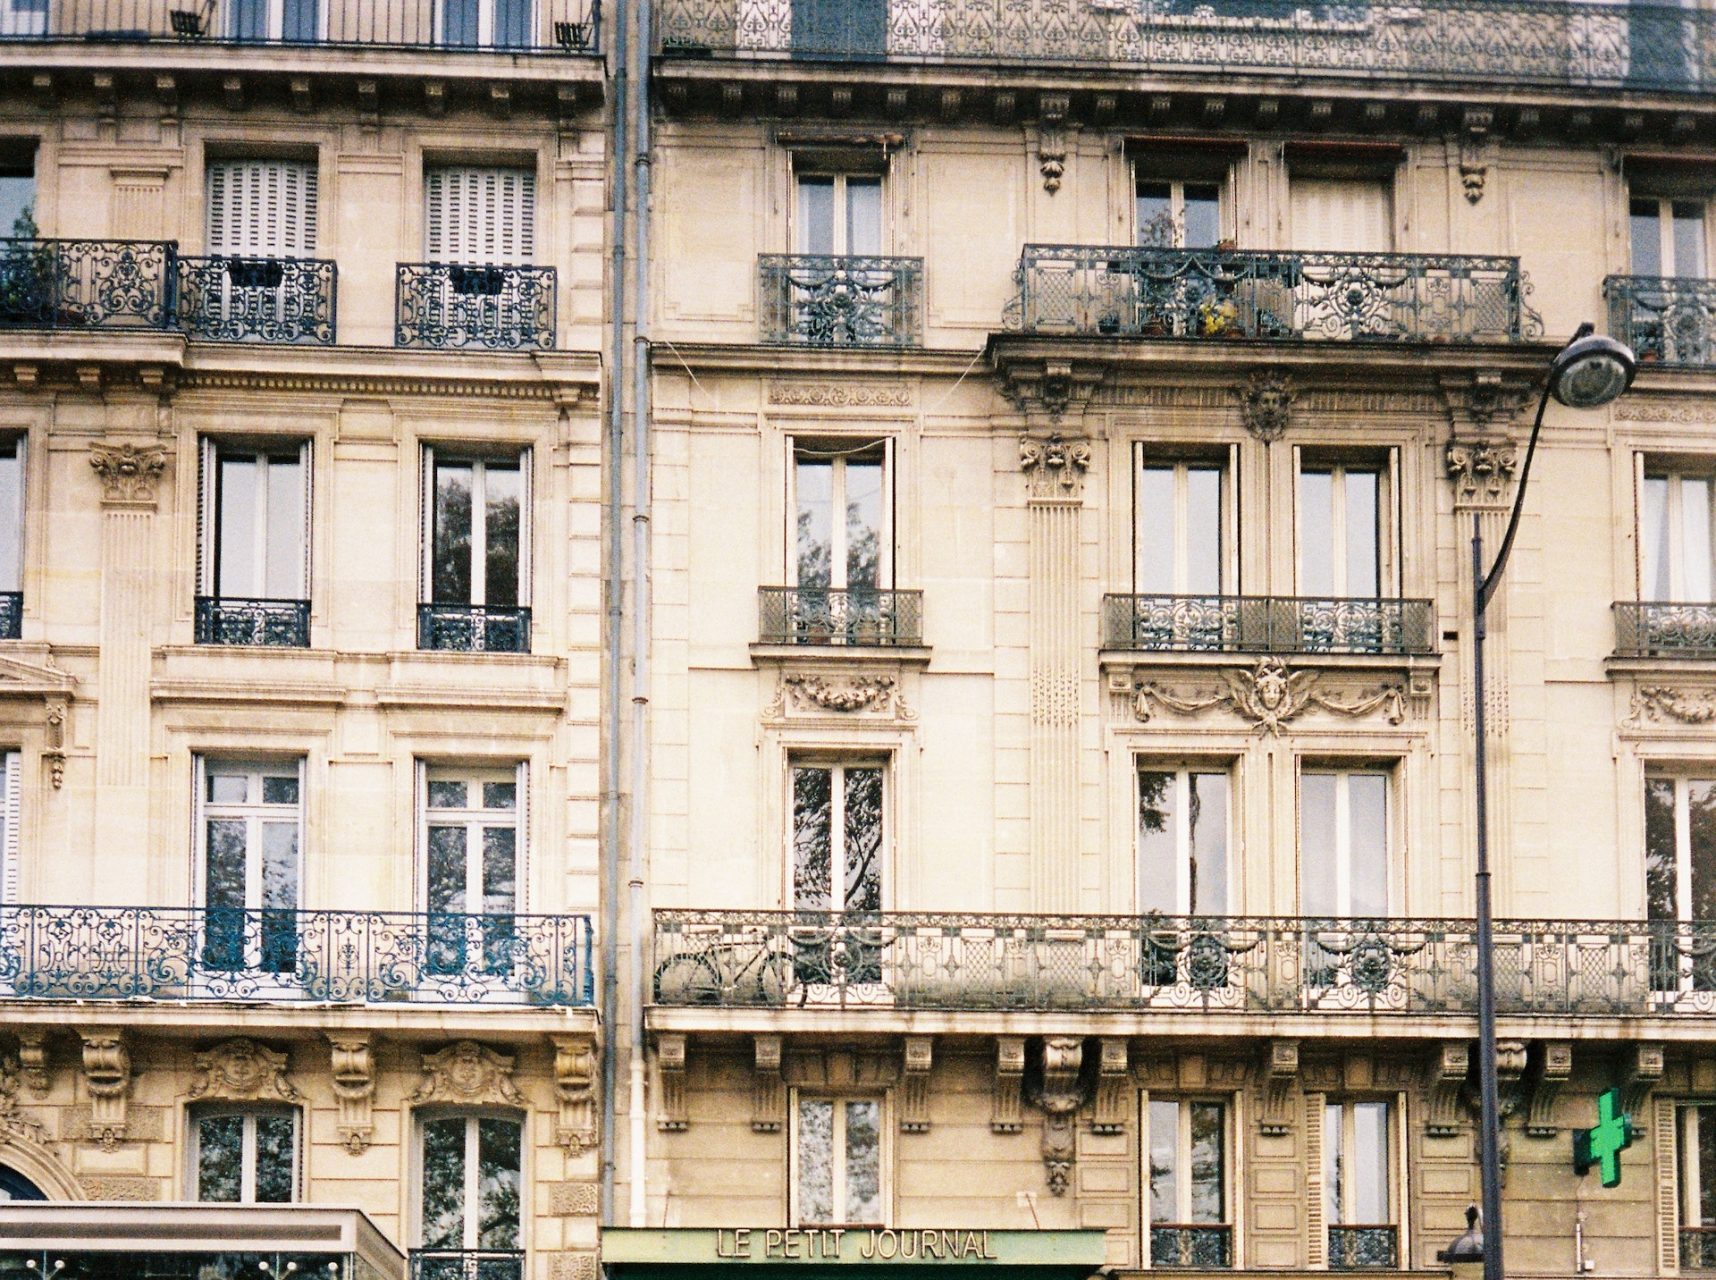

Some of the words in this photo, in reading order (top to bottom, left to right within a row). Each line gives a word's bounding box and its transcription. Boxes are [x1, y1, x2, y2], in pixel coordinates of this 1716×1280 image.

[717, 1228, 751, 1258] LE
[766, 1228, 846, 1258] PETIT
[861, 1229, 998, 1259] JOURNAL
